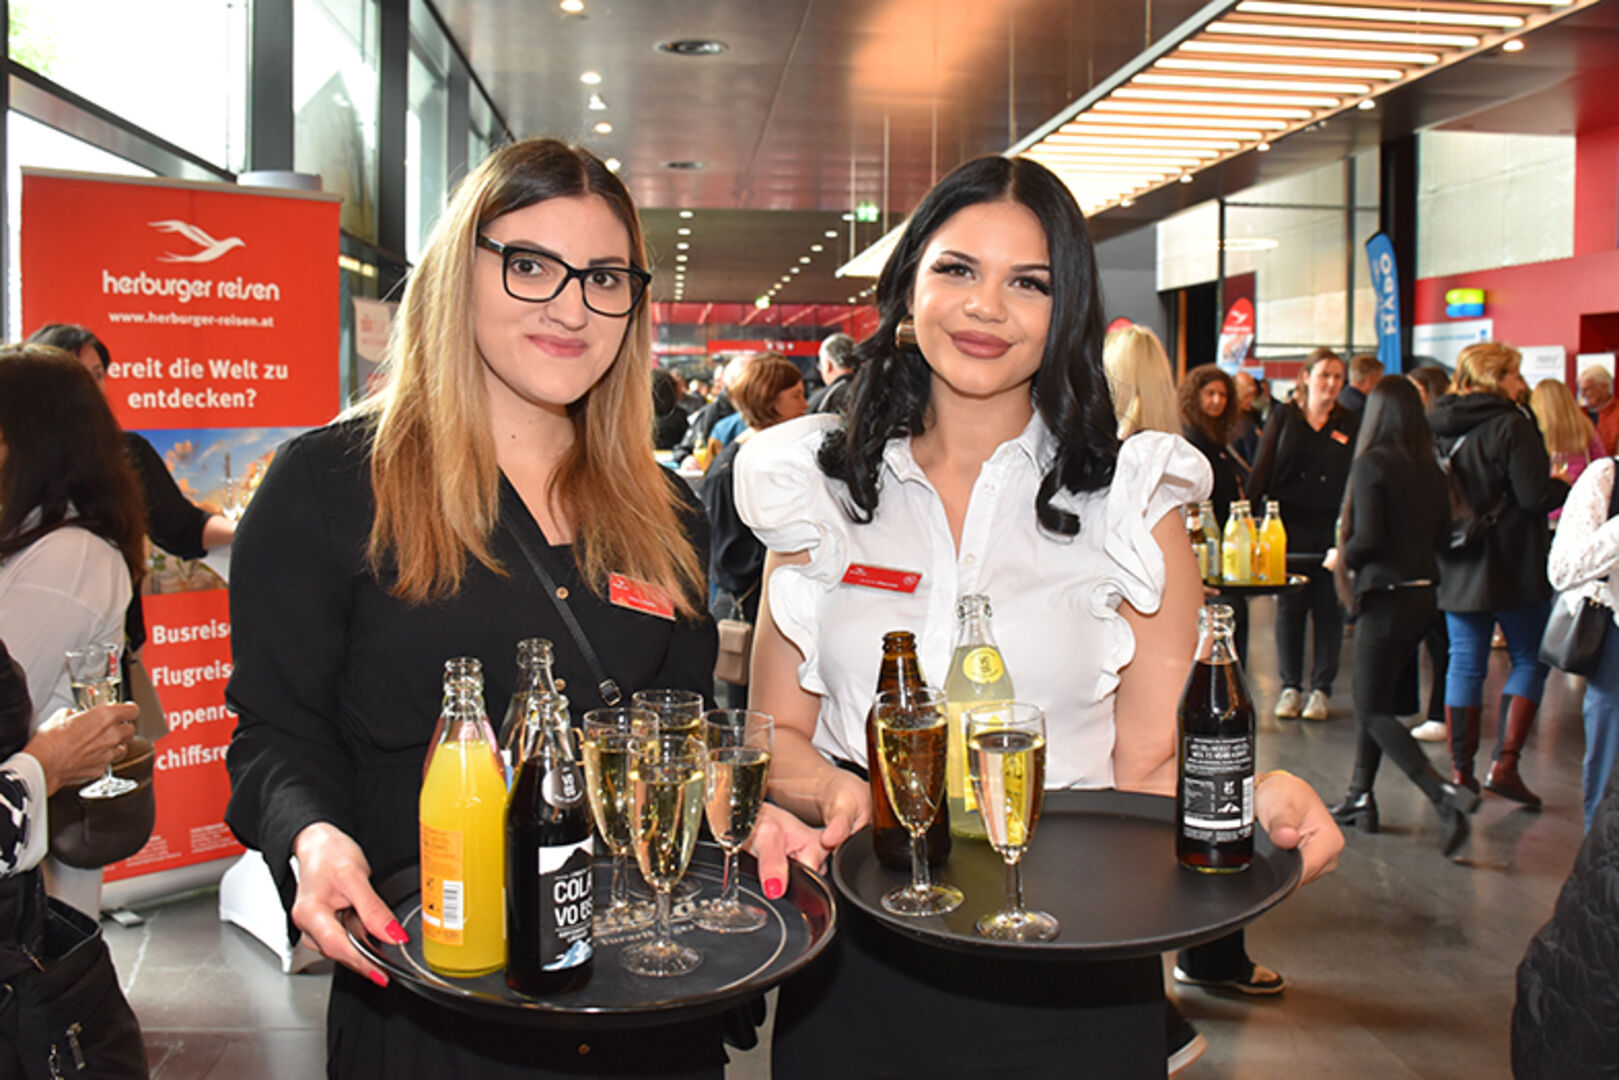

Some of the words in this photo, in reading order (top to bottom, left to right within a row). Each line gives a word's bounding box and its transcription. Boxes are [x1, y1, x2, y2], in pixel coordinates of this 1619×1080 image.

[102, 269, 213, 303] herburger
[217, 276, 281, 301] reisen
[108, 311, 274, 328] www.herburger-reisen.at
[106, 357, 163, 379] ereit
[168, 357, 204, 379] die
[208, 359, 259, 379] Welt
[263, 364, 289, 380] zu
[127, 387, 258, 409] entdecken?
[151, 660, 233, 688] Flugreis
[164, 705, 238, 731] ppenr
[155, 744, 228, 770] chiffsr
[554, 904, 579, 927] VO
